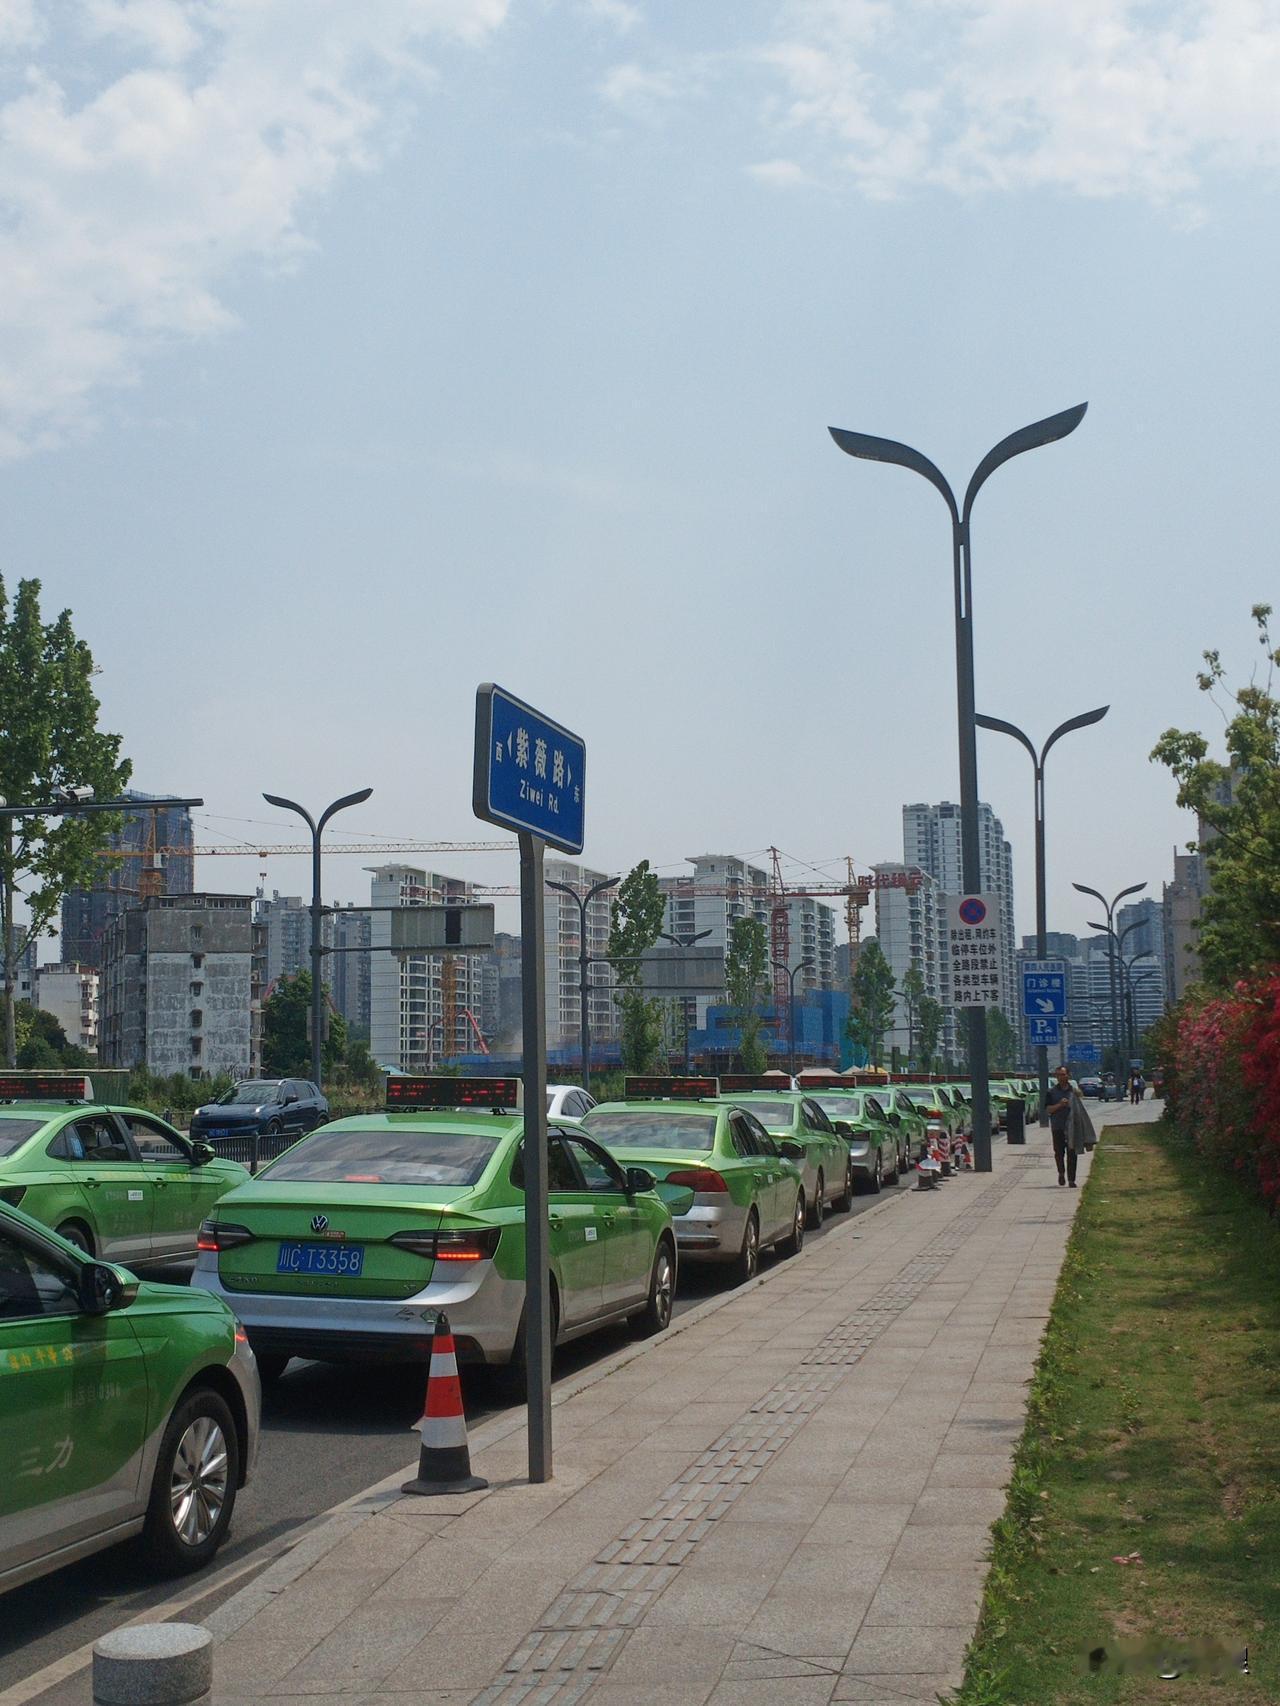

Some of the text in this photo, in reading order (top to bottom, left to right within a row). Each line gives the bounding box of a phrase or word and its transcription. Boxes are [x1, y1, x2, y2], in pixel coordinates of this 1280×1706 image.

[495, 741, 503, 763] 西
[516, 728, 564, 789] 紫薇路
[520, 779, 543, 807] Ziwei
[951, 943, 997, 956] 临停车位外
[952, 958, 998, 971] 全路段禁止
[953, 973, 999, 986] 各类型车辆
[954, 989, 999, 1002] 路内上下客
